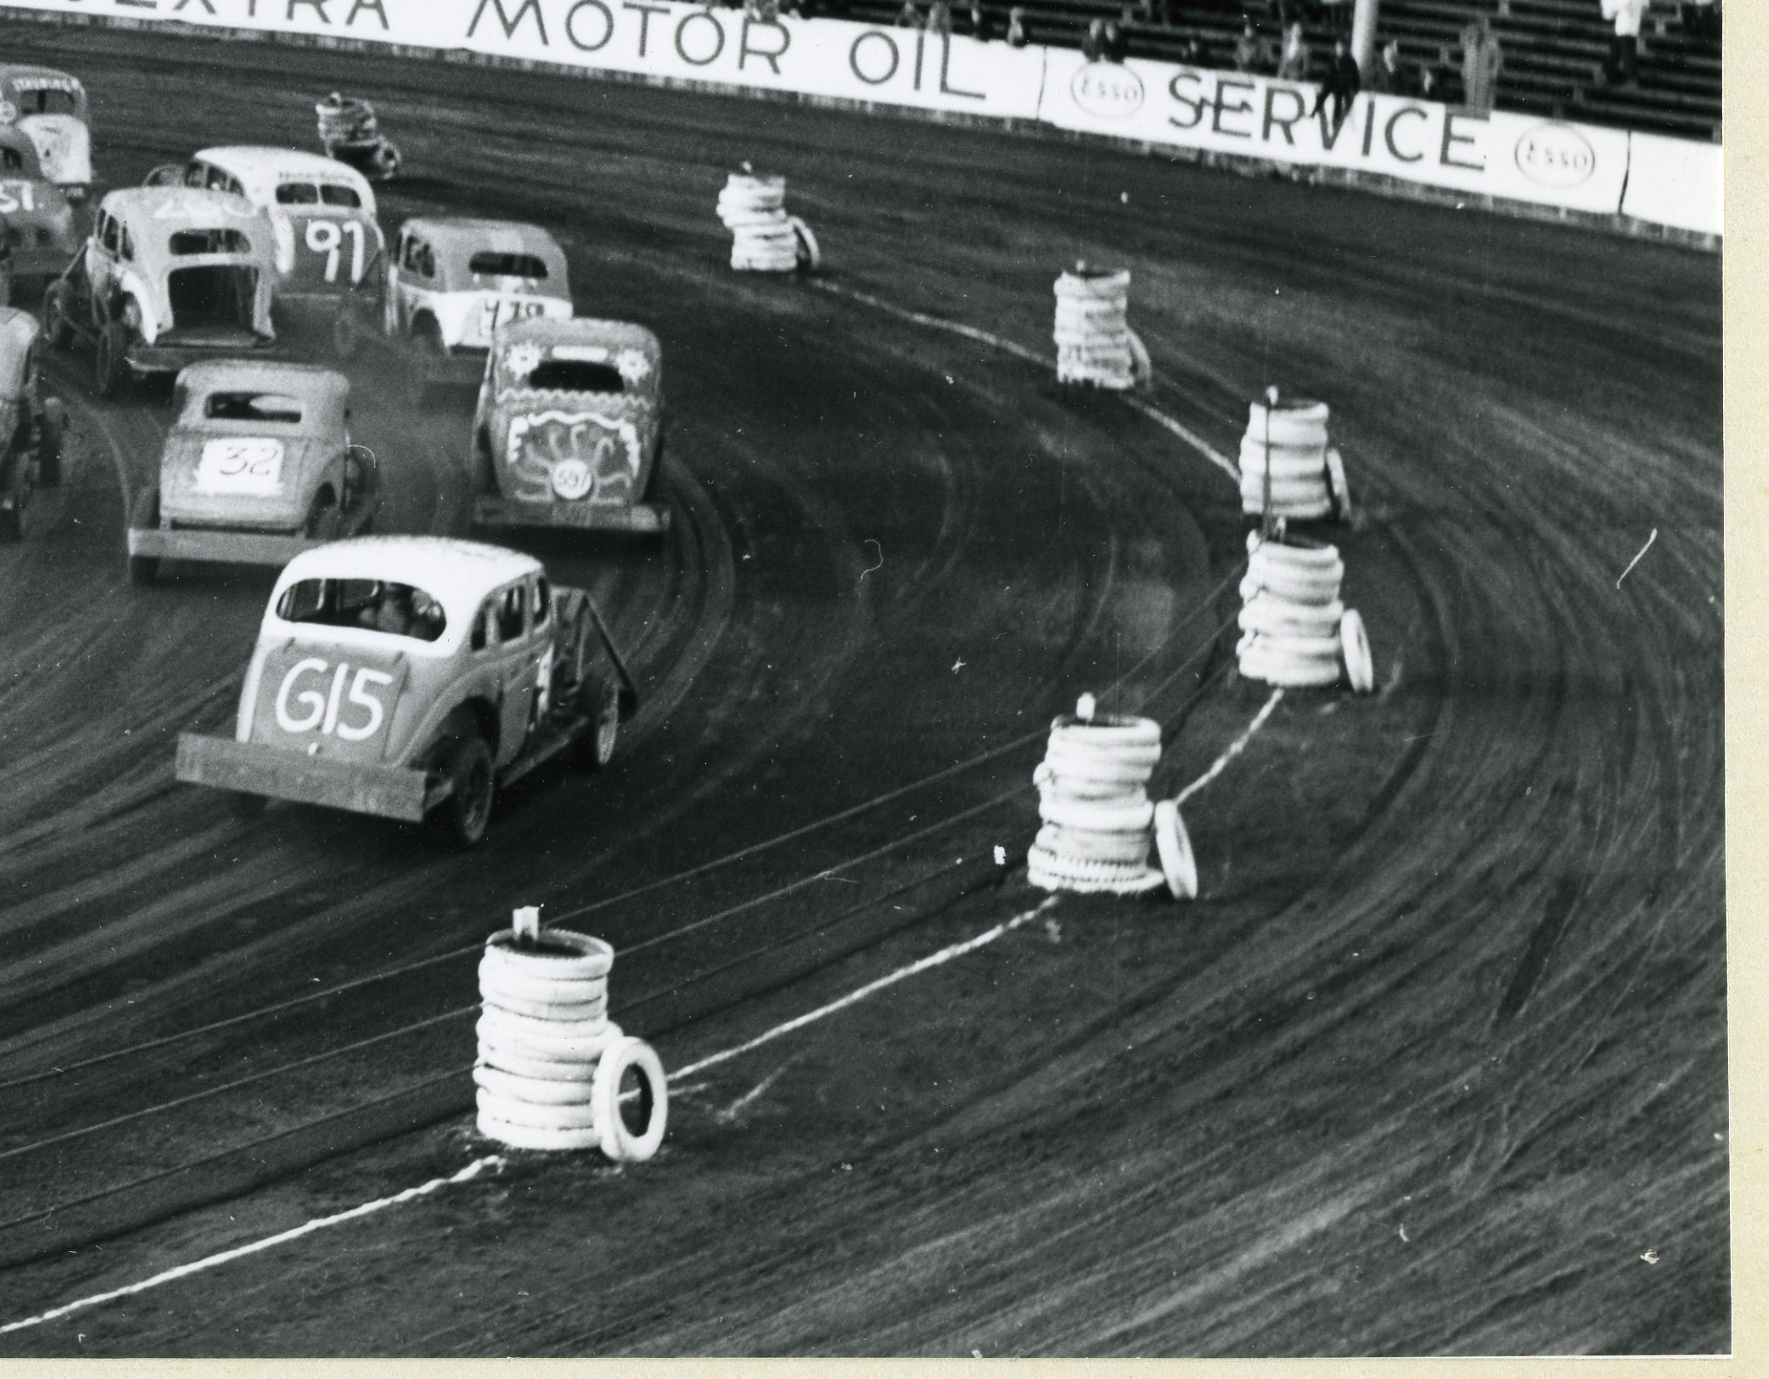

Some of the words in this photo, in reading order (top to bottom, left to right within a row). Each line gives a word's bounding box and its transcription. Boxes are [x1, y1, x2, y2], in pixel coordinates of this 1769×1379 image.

[848, 28, 987, 100] OIL
[1167, 71, 1486, 173] SERVICE
[305, 218, 365, 284] 91
[217, 446, 279, 476] 32
[275, 658, 392, 740] G15
